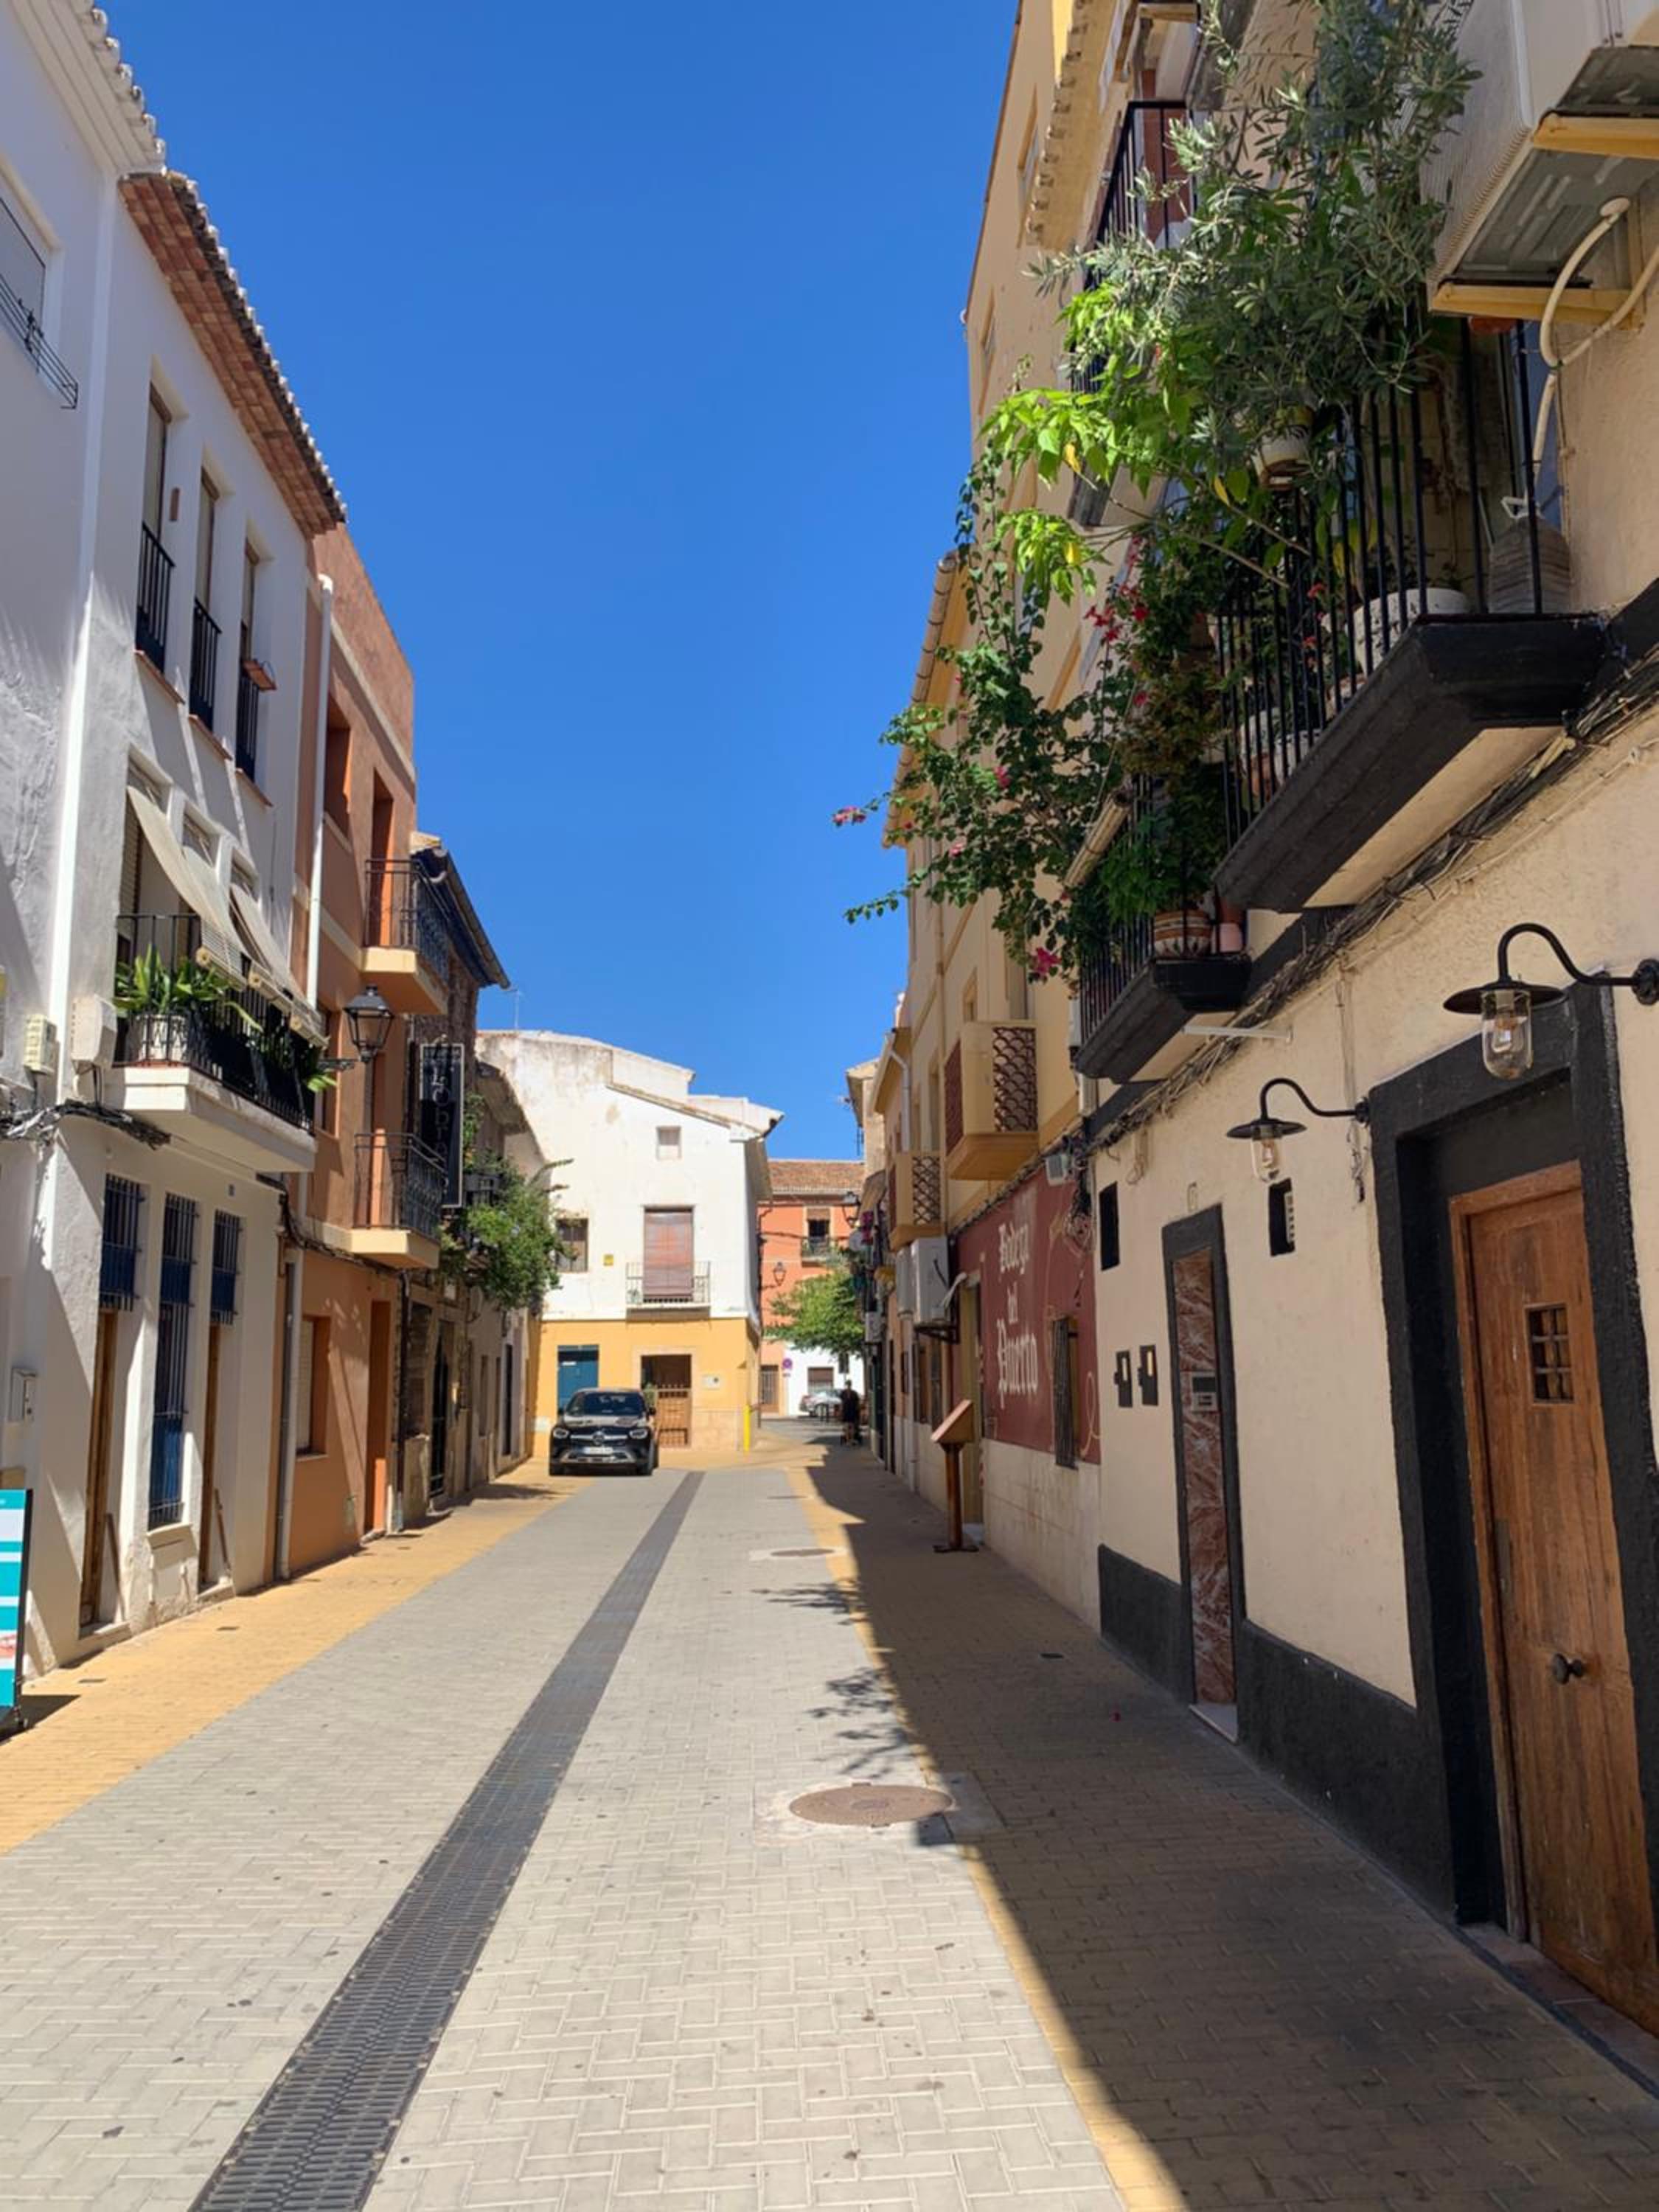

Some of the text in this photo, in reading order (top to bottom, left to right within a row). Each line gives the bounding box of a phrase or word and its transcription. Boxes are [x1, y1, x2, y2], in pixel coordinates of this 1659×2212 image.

[998, 1221, 1029, 1275] Bodega
[1007, 1281, 1018, 1325] del
[996, 1318, 1038, 1410] Puerto
